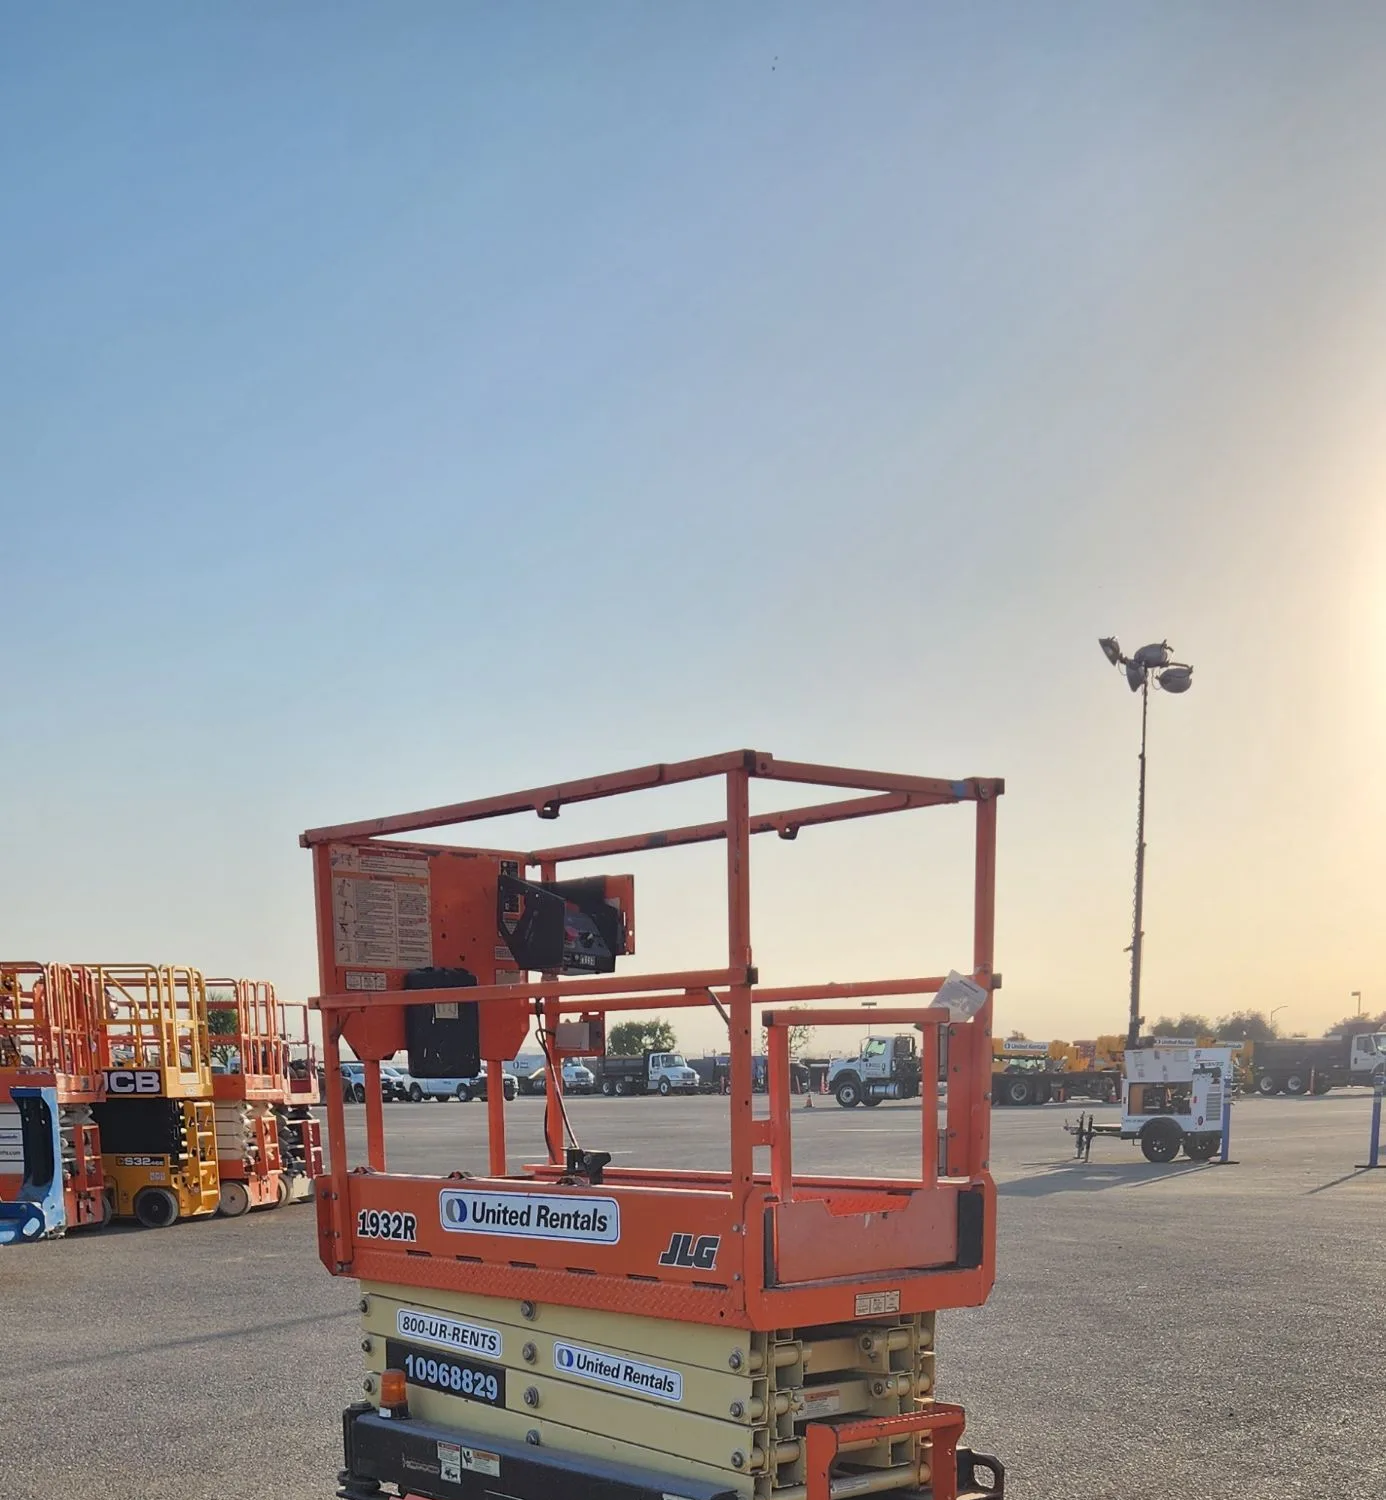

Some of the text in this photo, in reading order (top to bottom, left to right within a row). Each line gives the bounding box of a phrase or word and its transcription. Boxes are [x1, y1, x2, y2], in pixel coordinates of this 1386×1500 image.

[357, 1203, 417, 1243] 1932R
[472, 1200, 608, 1233] United Rentals
[658, 1232, 721, 1271] JLG
[402, 1316, 497, 1351] 800-UR-RENTS
[405, 1353, 498, 1400] 10968829
[576, 1353, 675, 1393] United Rentals
